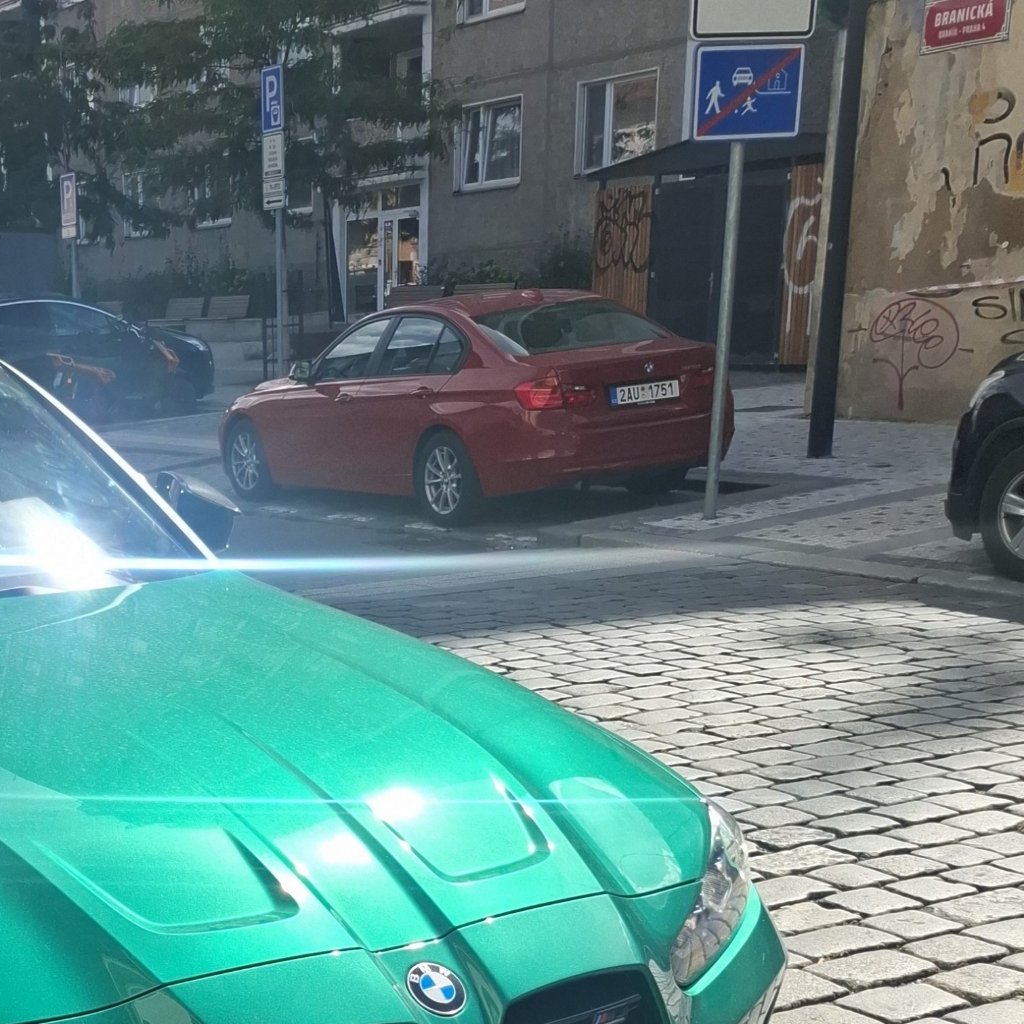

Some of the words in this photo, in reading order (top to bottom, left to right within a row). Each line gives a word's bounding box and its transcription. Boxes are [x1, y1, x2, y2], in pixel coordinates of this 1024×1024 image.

[934, 0, 994, 27] BRANICKÁ
[620, 387, 640, 402] 2AU
[648, 383, 674, 398] 1751
[409, 963, 452, 983] BMW
